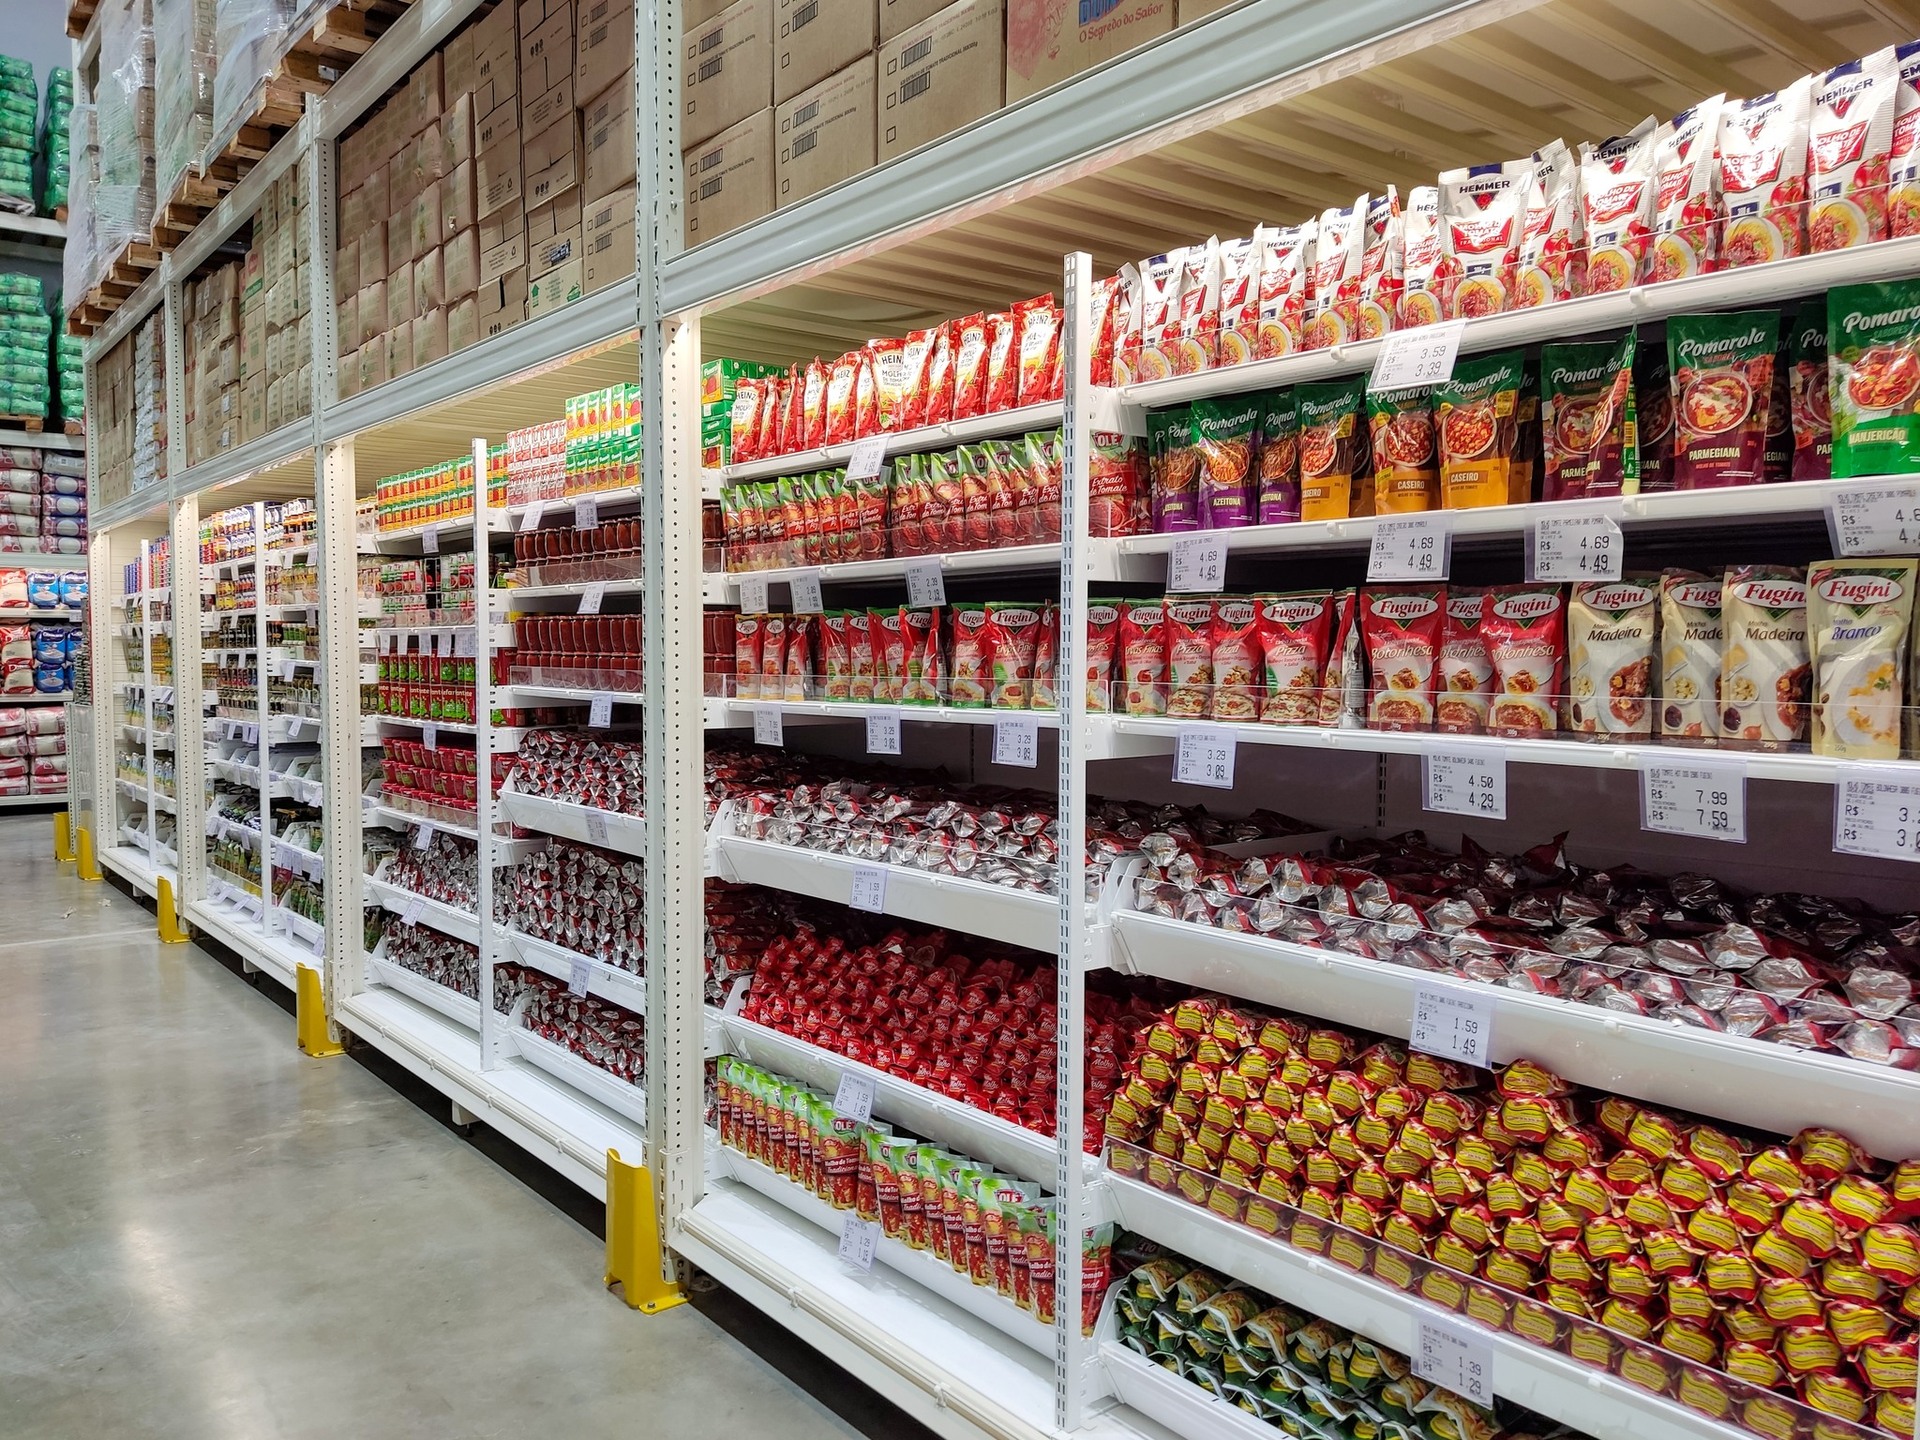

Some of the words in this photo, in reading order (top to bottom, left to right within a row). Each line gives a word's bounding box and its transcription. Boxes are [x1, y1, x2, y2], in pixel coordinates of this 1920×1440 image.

[1079, 30, 1087, 43] O
[1088, 18, 1122, 40] Segredo
[1124, 12, 1134, 26] do
[1135, 4, 1164, 22] Sabor
[1816, 78, 1873, 106] HEMMER
[1459, 180, 1510, 194] HEMMER
[1678, 328, 1766, 358] Pomarola
[1420, 345, 1447, 359] 3.59
[1414, 360, 1442, 377] 3.39
[1443, 366, 1512, 395] Pomarola
[1302, 393, 1352, 415] Pomarola
[1200, 408, 1258, 432] Pomarola
[1689, 447, 1740, 460] PARMEGIANA
[1092, 475, 1122, 486] Extrato
[1398, 480, 1424, 490] CASEIRO
[1450, 472, 1478, 483] CASEIRO
[1098, 484, 1128, 496] Tomate
[1213, 498, 1240, 506] AZEITONA
[1410, 536, 1434, 550] 4.69
[1580, 536, 1610, 550] 4.69
[1200, 550, 1218, 562] 4.69
[1408, 554, 1432, 568] 4.49
[1580, 554, 1608, 571] 4.49
[1199, 565, 1216, 579] 4.49
[1591, 589, 1645, 608] Fugini
[1828, 580, 1891, 602] Fugini
[1270, 605, 1316, 621] Fugini
[1379, 600, 1429, 617] Fugini
[1503, 596, 1552, 615] Fugini
[997, 612, 1032, 626] Fugini
[1588, 626, 1642, 641] Madeira
[1745, 628, 1805, 642] Madeira
[1831, 625, 1882, 640] Branco
[1177, 644, 1203, 654] Pizza
[1276, 646, 1307, 656] Pizza
[1017, 735, 1031, 744] 3.29
[1207, 750, 1226, 760] 3.29
[1206, 764, 1225, 777] 3.09
[1468, 775, 1494, 788] 4.50
[1468, 792, 1494, 809] 4.29
[1696, 790, 1728, 806] 7.99
[1696, 809, 1728, 828] 7.59
[1898, 807, 1920, 824] 3.
[1454, 1017, 1478, 1034] 1.59
[1452, 1034, 1476, 1054] 1.49
[1092, 1058, 1114, 1068] Molho
[1459, 1356, 1481, 1376] 1.39
[1459, 1373, 1481, 1395] 1.29
